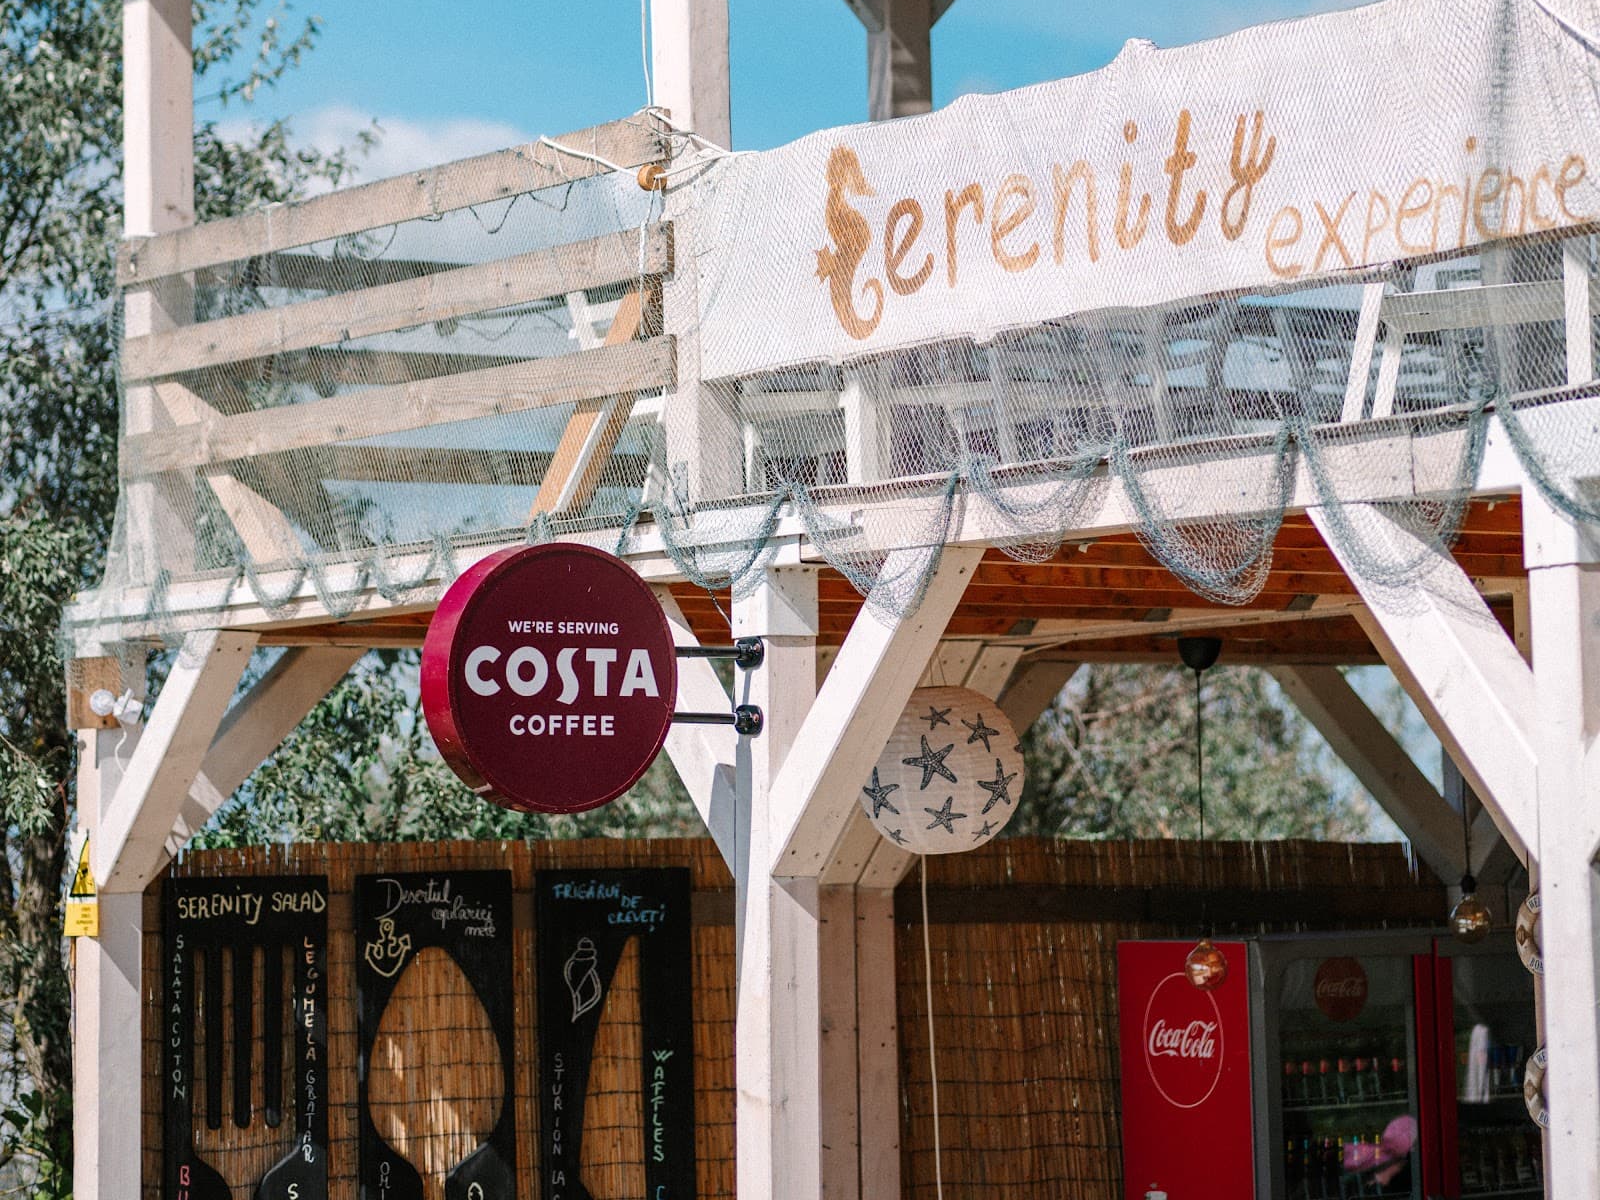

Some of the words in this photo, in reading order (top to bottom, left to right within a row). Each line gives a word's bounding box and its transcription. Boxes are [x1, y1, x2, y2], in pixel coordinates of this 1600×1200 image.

[1265, 135, 1598, 277] experience
[508, 620, 553, 634] WE'RE
[558, 621, 620, 635] SERVING
[464, 645, 659, 705] COSTA
[509, 715, 615, 736] COFFEE
[178, 885, 263, 925] SERENITY
[272, 889, 327, 913] SALAD
[375, 878, 451, 921] Desertul
[620, 895, 643, 909] DE
[1149, 1019, 1218, 1059] Coca-Cola
[651, 1050, 674, 1162] WAFFLES
